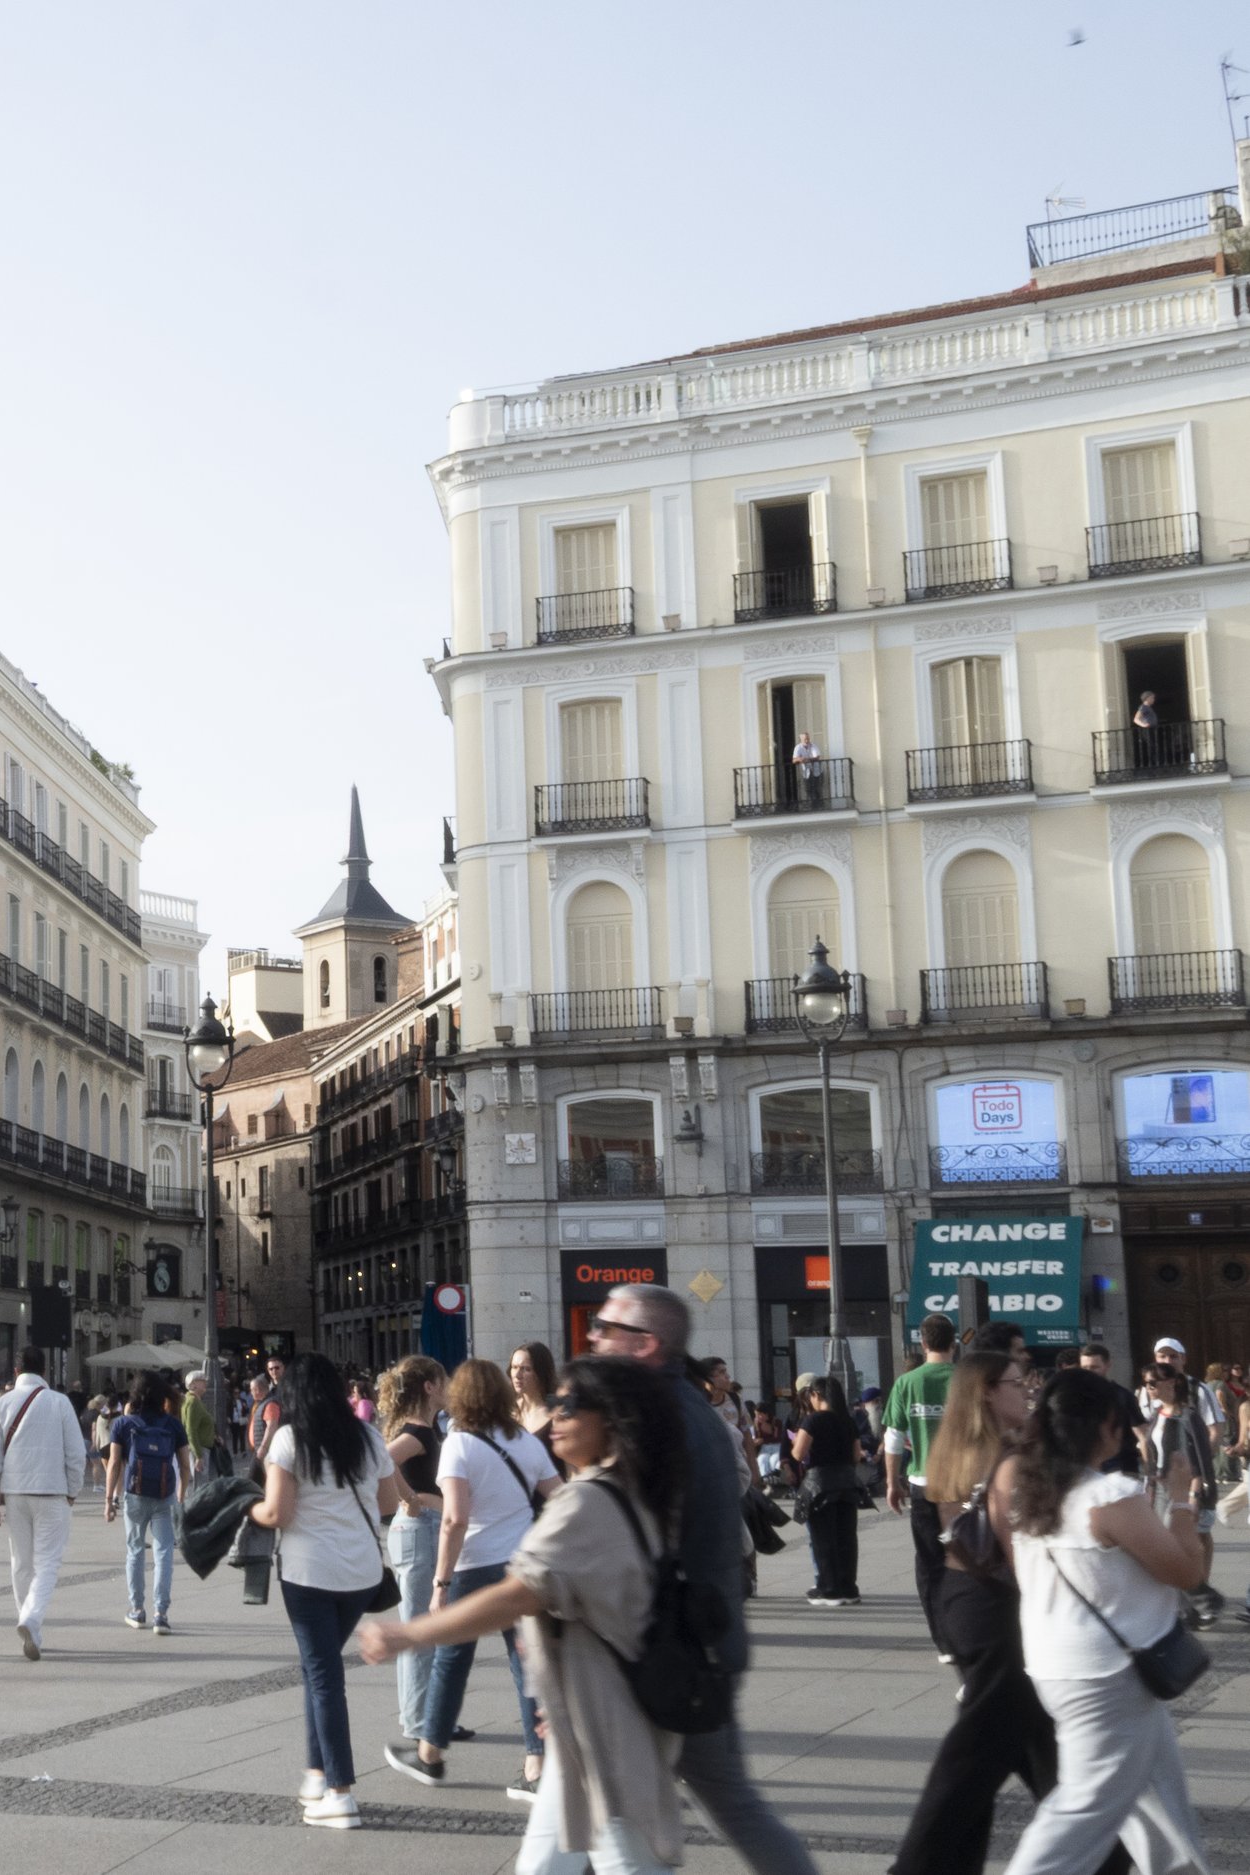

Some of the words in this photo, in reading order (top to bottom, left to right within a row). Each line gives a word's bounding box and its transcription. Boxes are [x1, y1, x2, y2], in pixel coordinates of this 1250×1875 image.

[980, 1100, 1014, 1111] Todo
[981, 1112, 1015, 1125] Days
[930, 1223, 1066, 1243] CHANGE
[576, 1264, 655, 1284] Orange
[928, 1260, 1064, 1276] TRANSFER
[807, 1280, 830, 1289] orang
